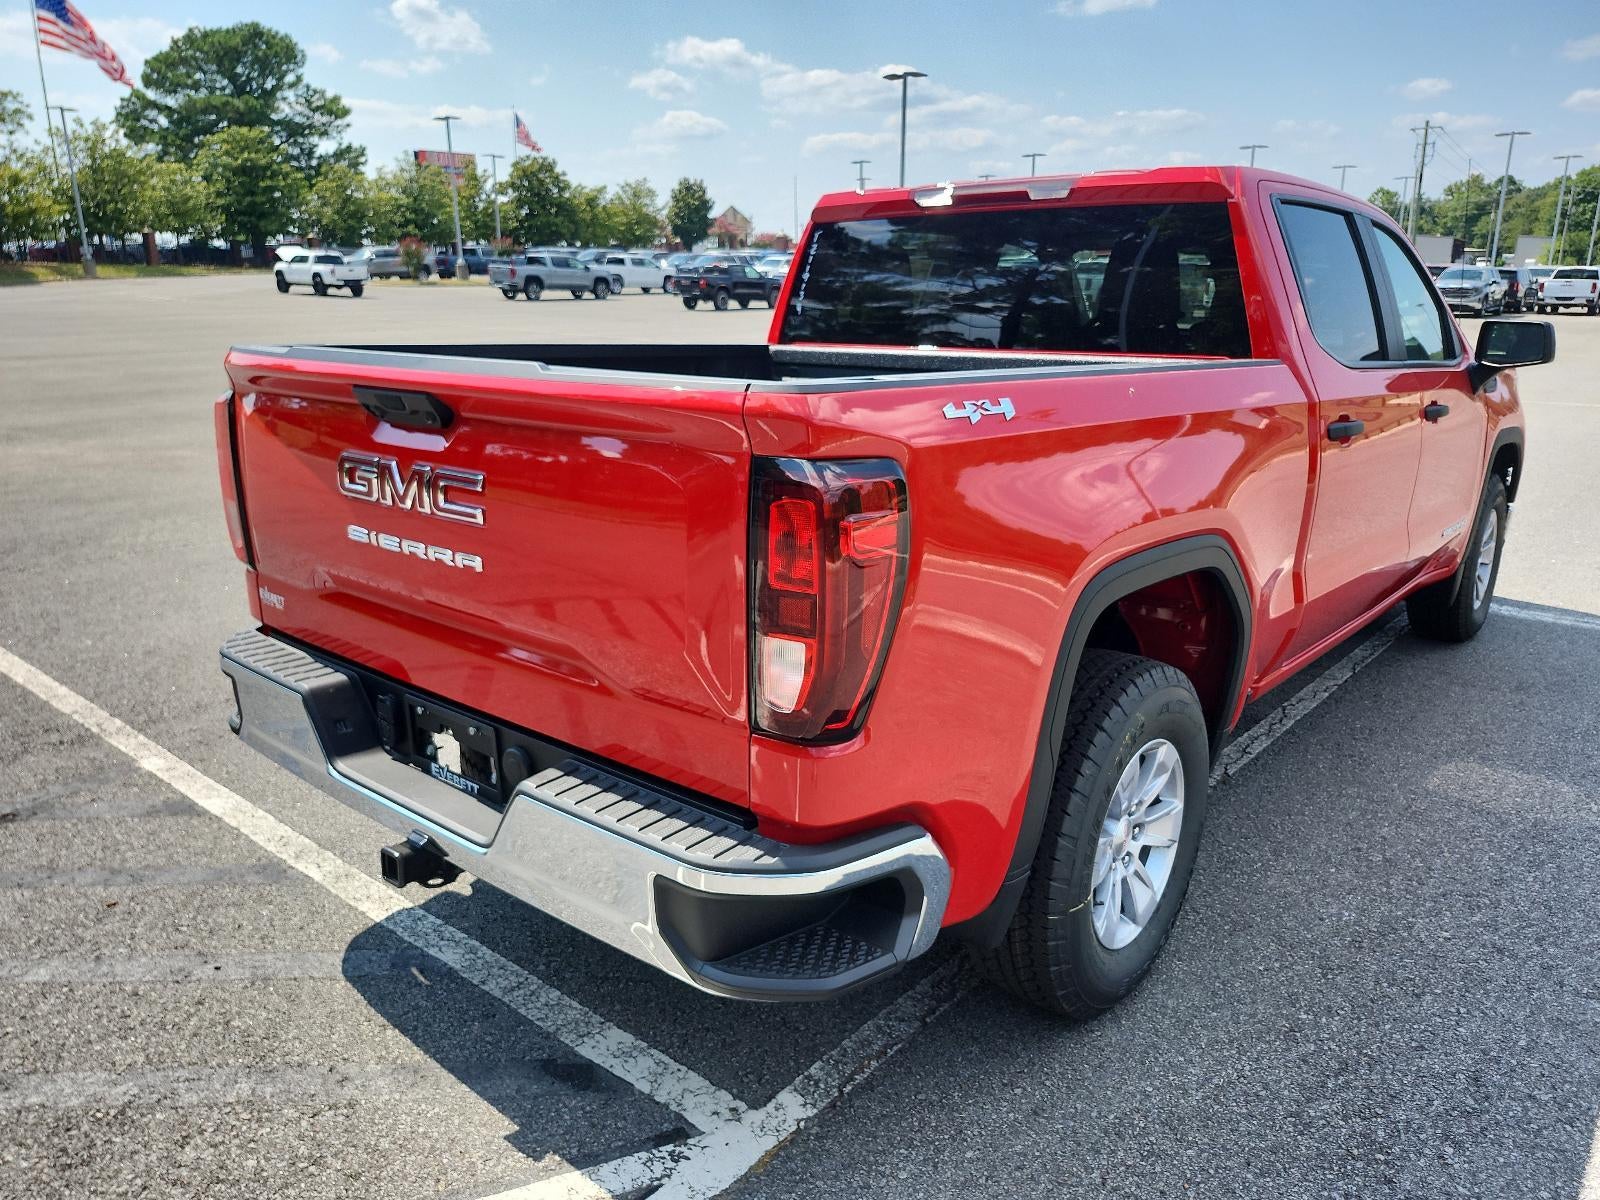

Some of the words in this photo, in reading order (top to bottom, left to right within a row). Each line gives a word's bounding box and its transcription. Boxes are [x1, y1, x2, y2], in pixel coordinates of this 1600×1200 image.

[337, 450, 486, 527] GMC
[347, 524, 484, 573] SIERRA
[431, 761, 480, 794] EVERETT
